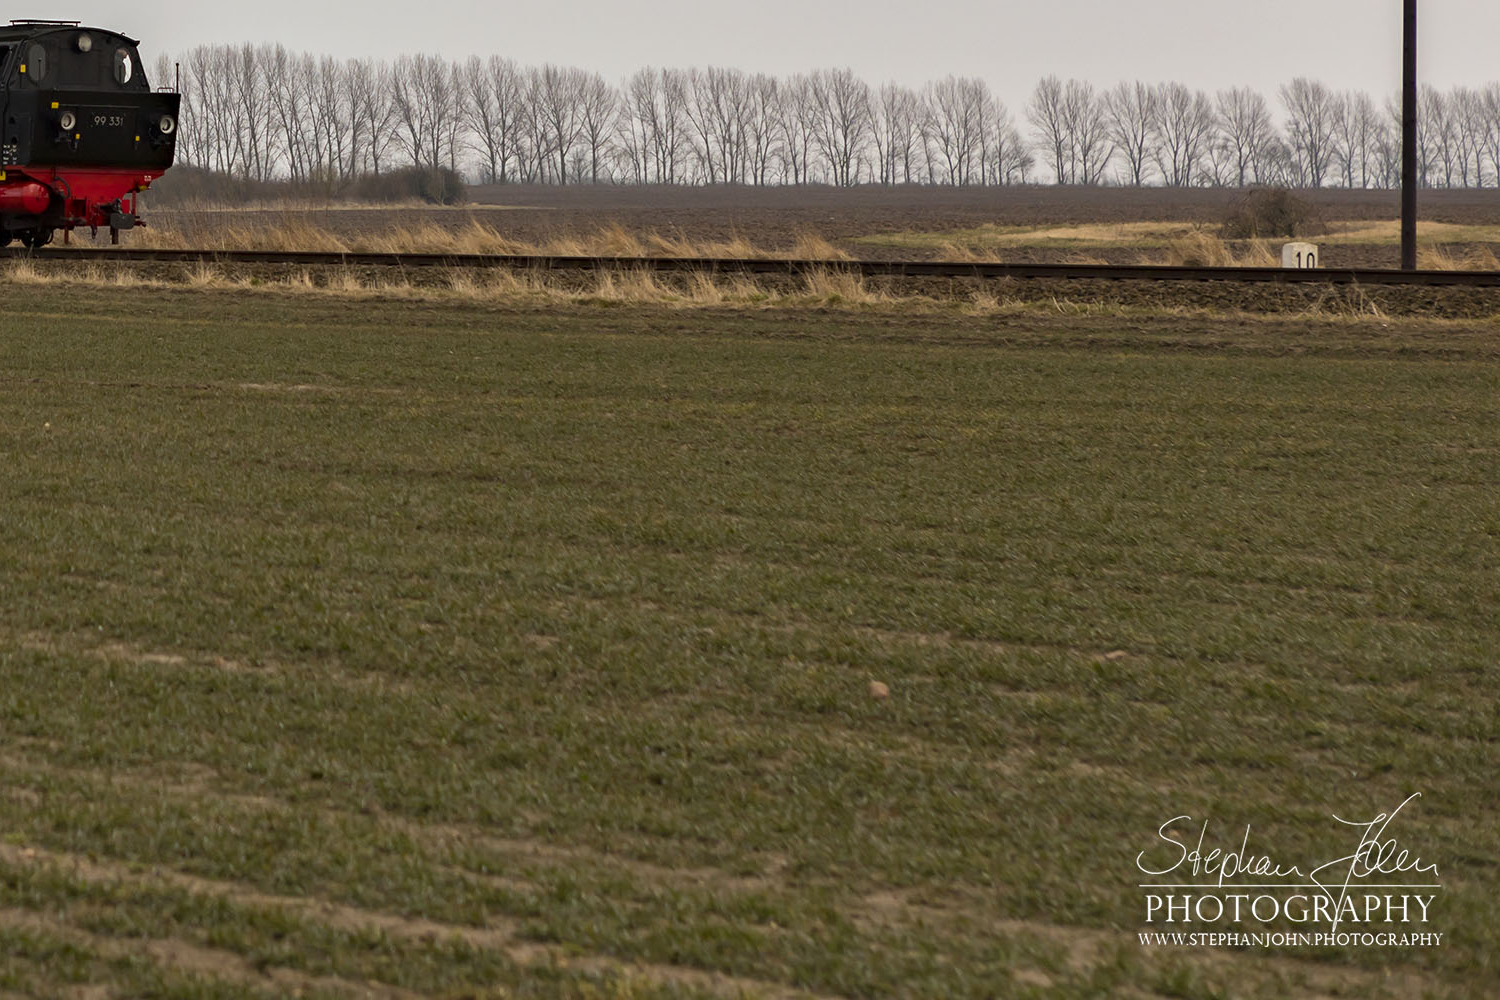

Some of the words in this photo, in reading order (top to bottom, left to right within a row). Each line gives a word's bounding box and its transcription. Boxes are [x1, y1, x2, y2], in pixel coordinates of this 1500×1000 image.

[94, 115, 107, 126] 99
[108, 116, 124, 126] 331
[1296, 251, 1315, 269] 10
